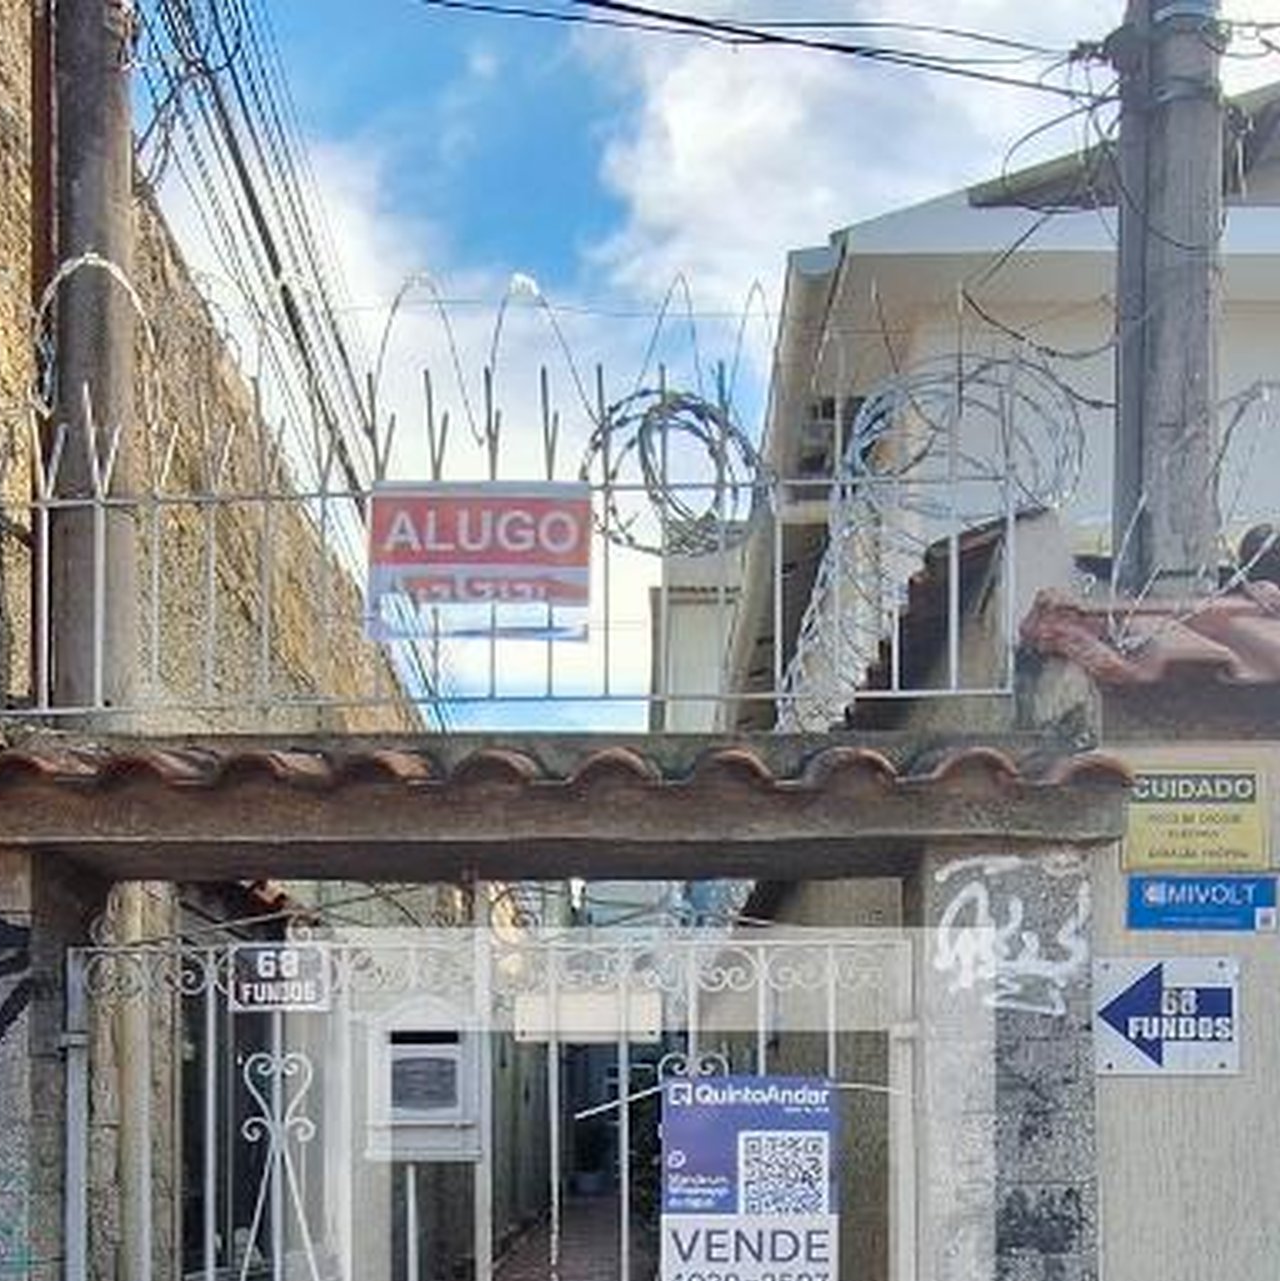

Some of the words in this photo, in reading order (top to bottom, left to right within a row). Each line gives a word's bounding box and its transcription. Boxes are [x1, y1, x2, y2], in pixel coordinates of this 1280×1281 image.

[384, 509, 579, 552] ALUGO
[1135, 778, 1253, 799] CUIDADO
[1161, 990, 1198, 1015] 68
[1128, 1016, 1232, 1040] FUNDOS
[694, 1084, 830, 1105] QuintoAndar
[671, 1229, 830, 1264] VENDE
